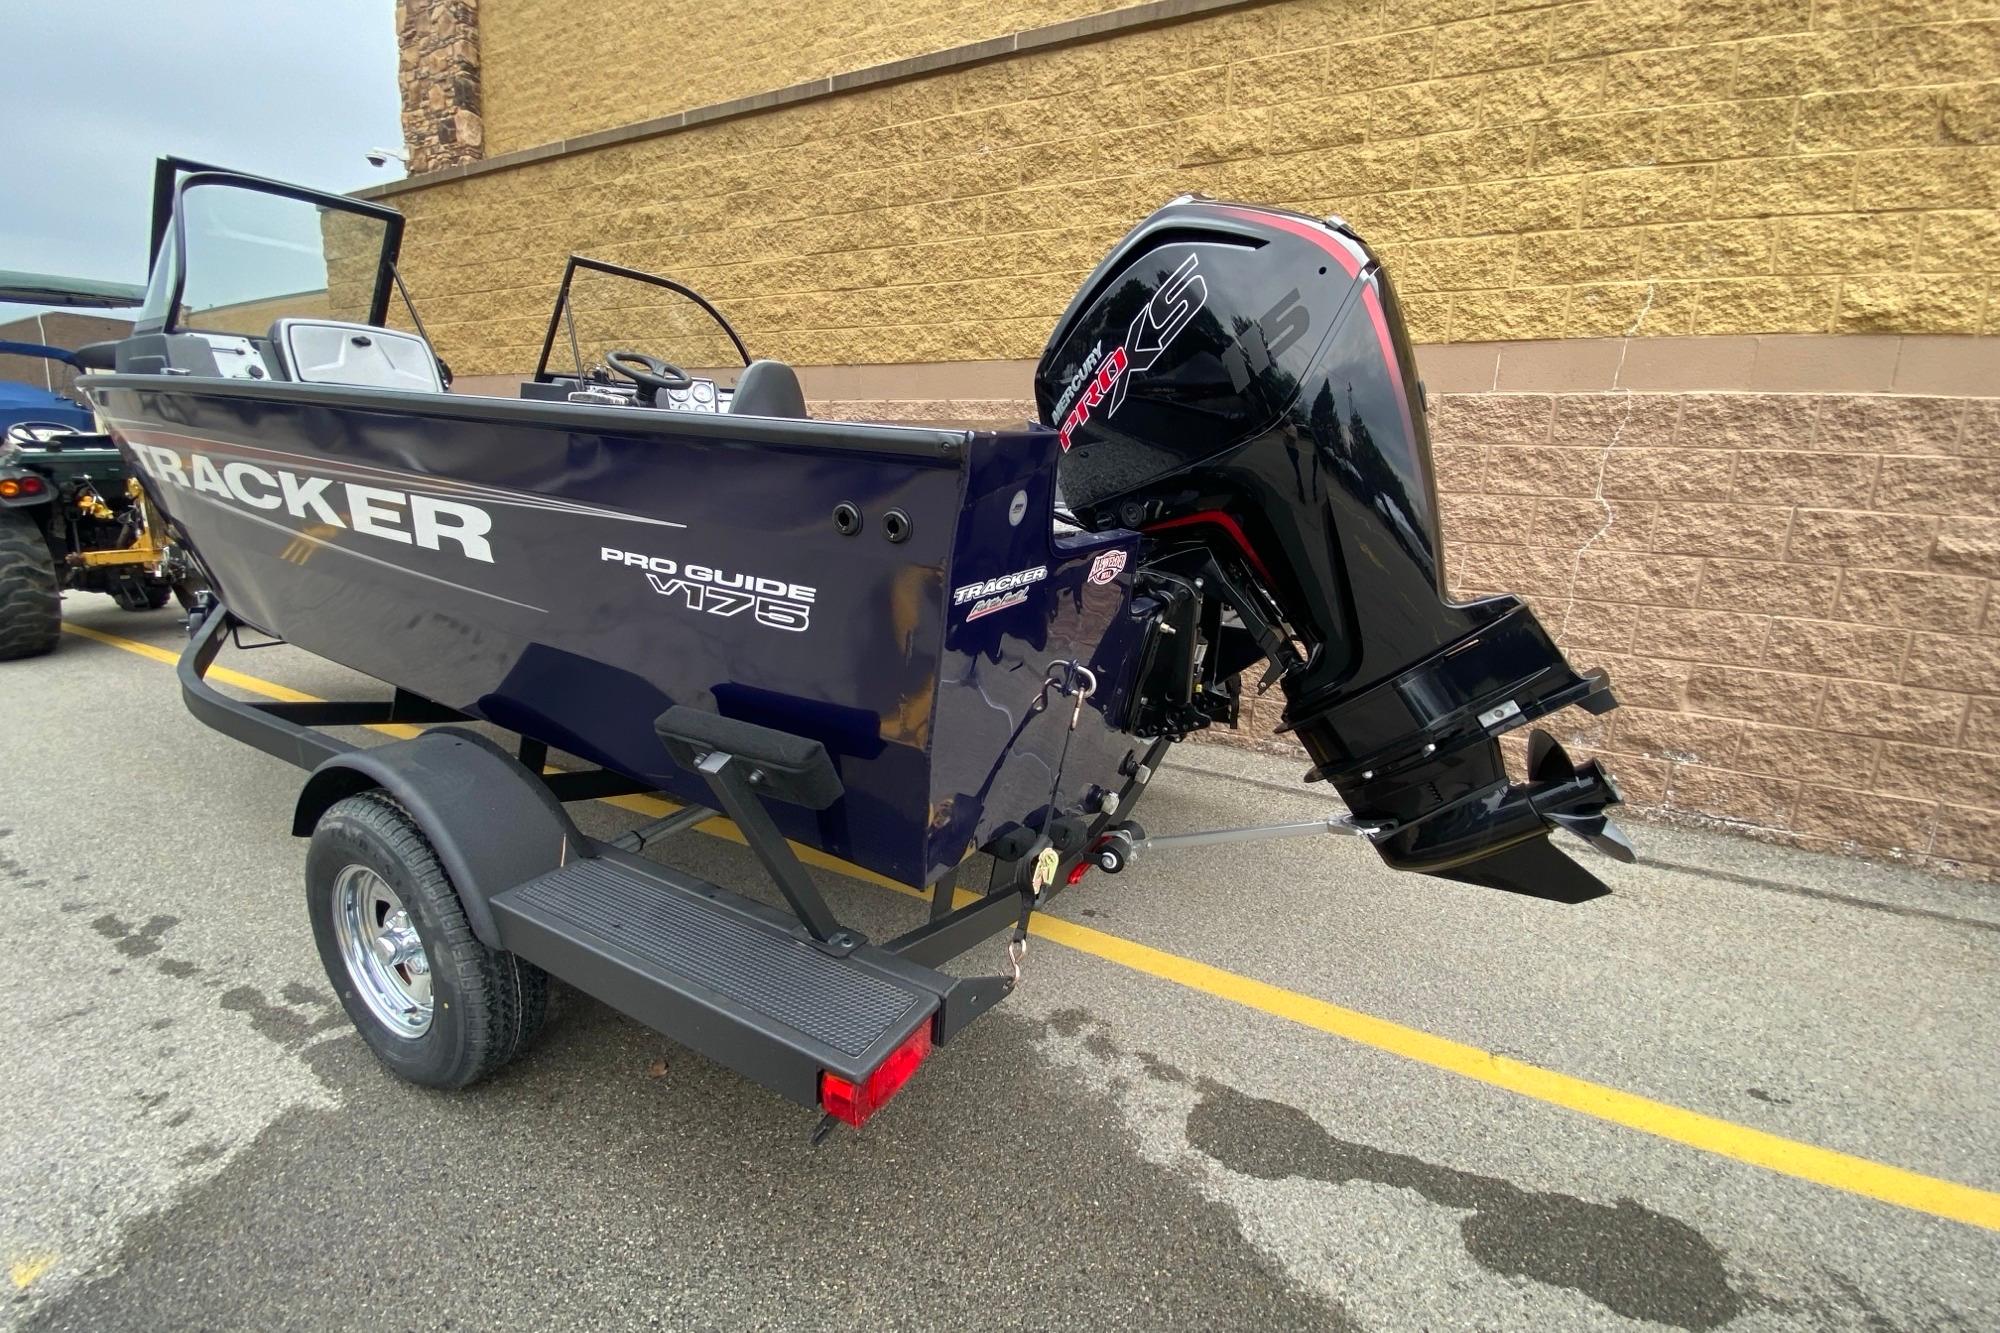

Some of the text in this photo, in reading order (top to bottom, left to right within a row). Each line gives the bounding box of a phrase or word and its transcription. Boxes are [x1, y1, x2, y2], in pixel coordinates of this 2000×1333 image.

[1051, 339, 1102, 426] MERCURY
[1060, 346, 1129, 454] PRO
[1107, 252, 1208, 420] XS
[1221, 288, 1310, 394] 115
[128, 441, 495, 563] TRACKER
[601, 546, 817, 603] PRO GUIDE
[645, 572, 810, 632] V175
[954, 566, 1048, 605] TRACKER
